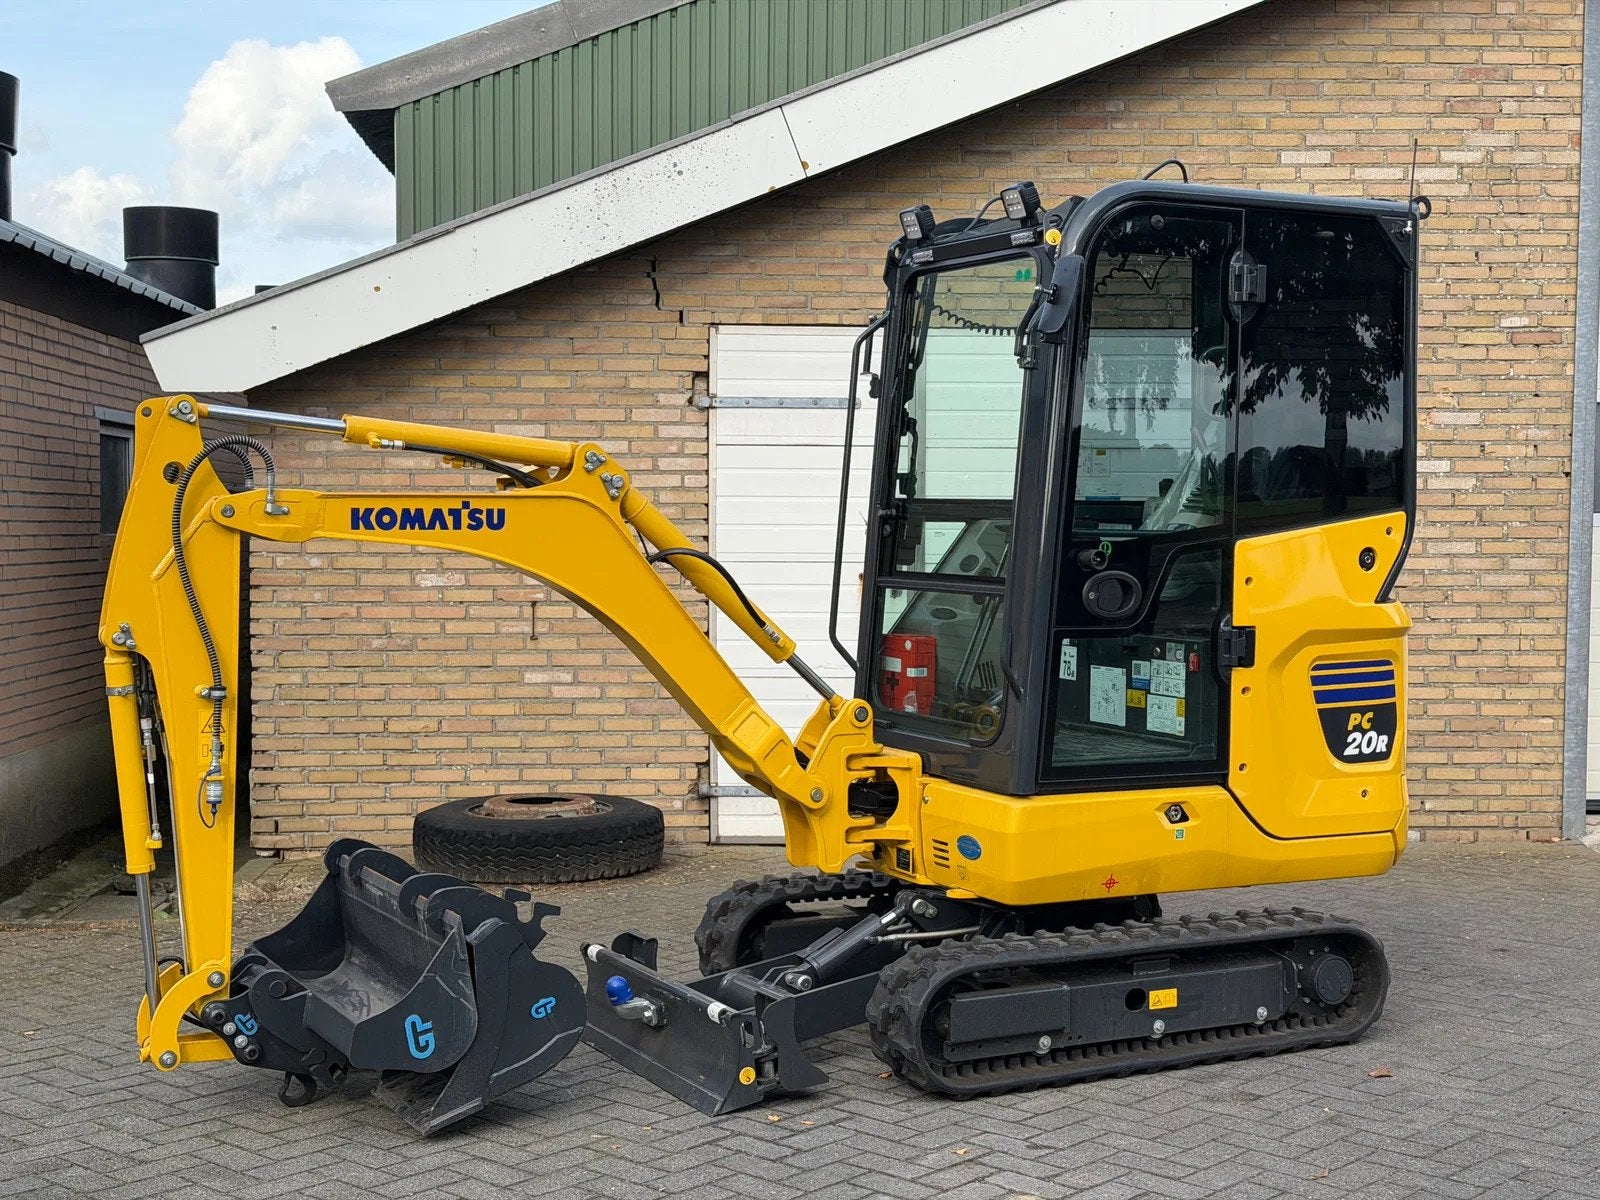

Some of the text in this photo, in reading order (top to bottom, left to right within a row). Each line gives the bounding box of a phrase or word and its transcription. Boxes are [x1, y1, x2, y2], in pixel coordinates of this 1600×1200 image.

[350, 500, 506, 532] KOMATSU
[1347, 711, 1374, 731] PC
[1343, 730, 1389, 756] 20R
